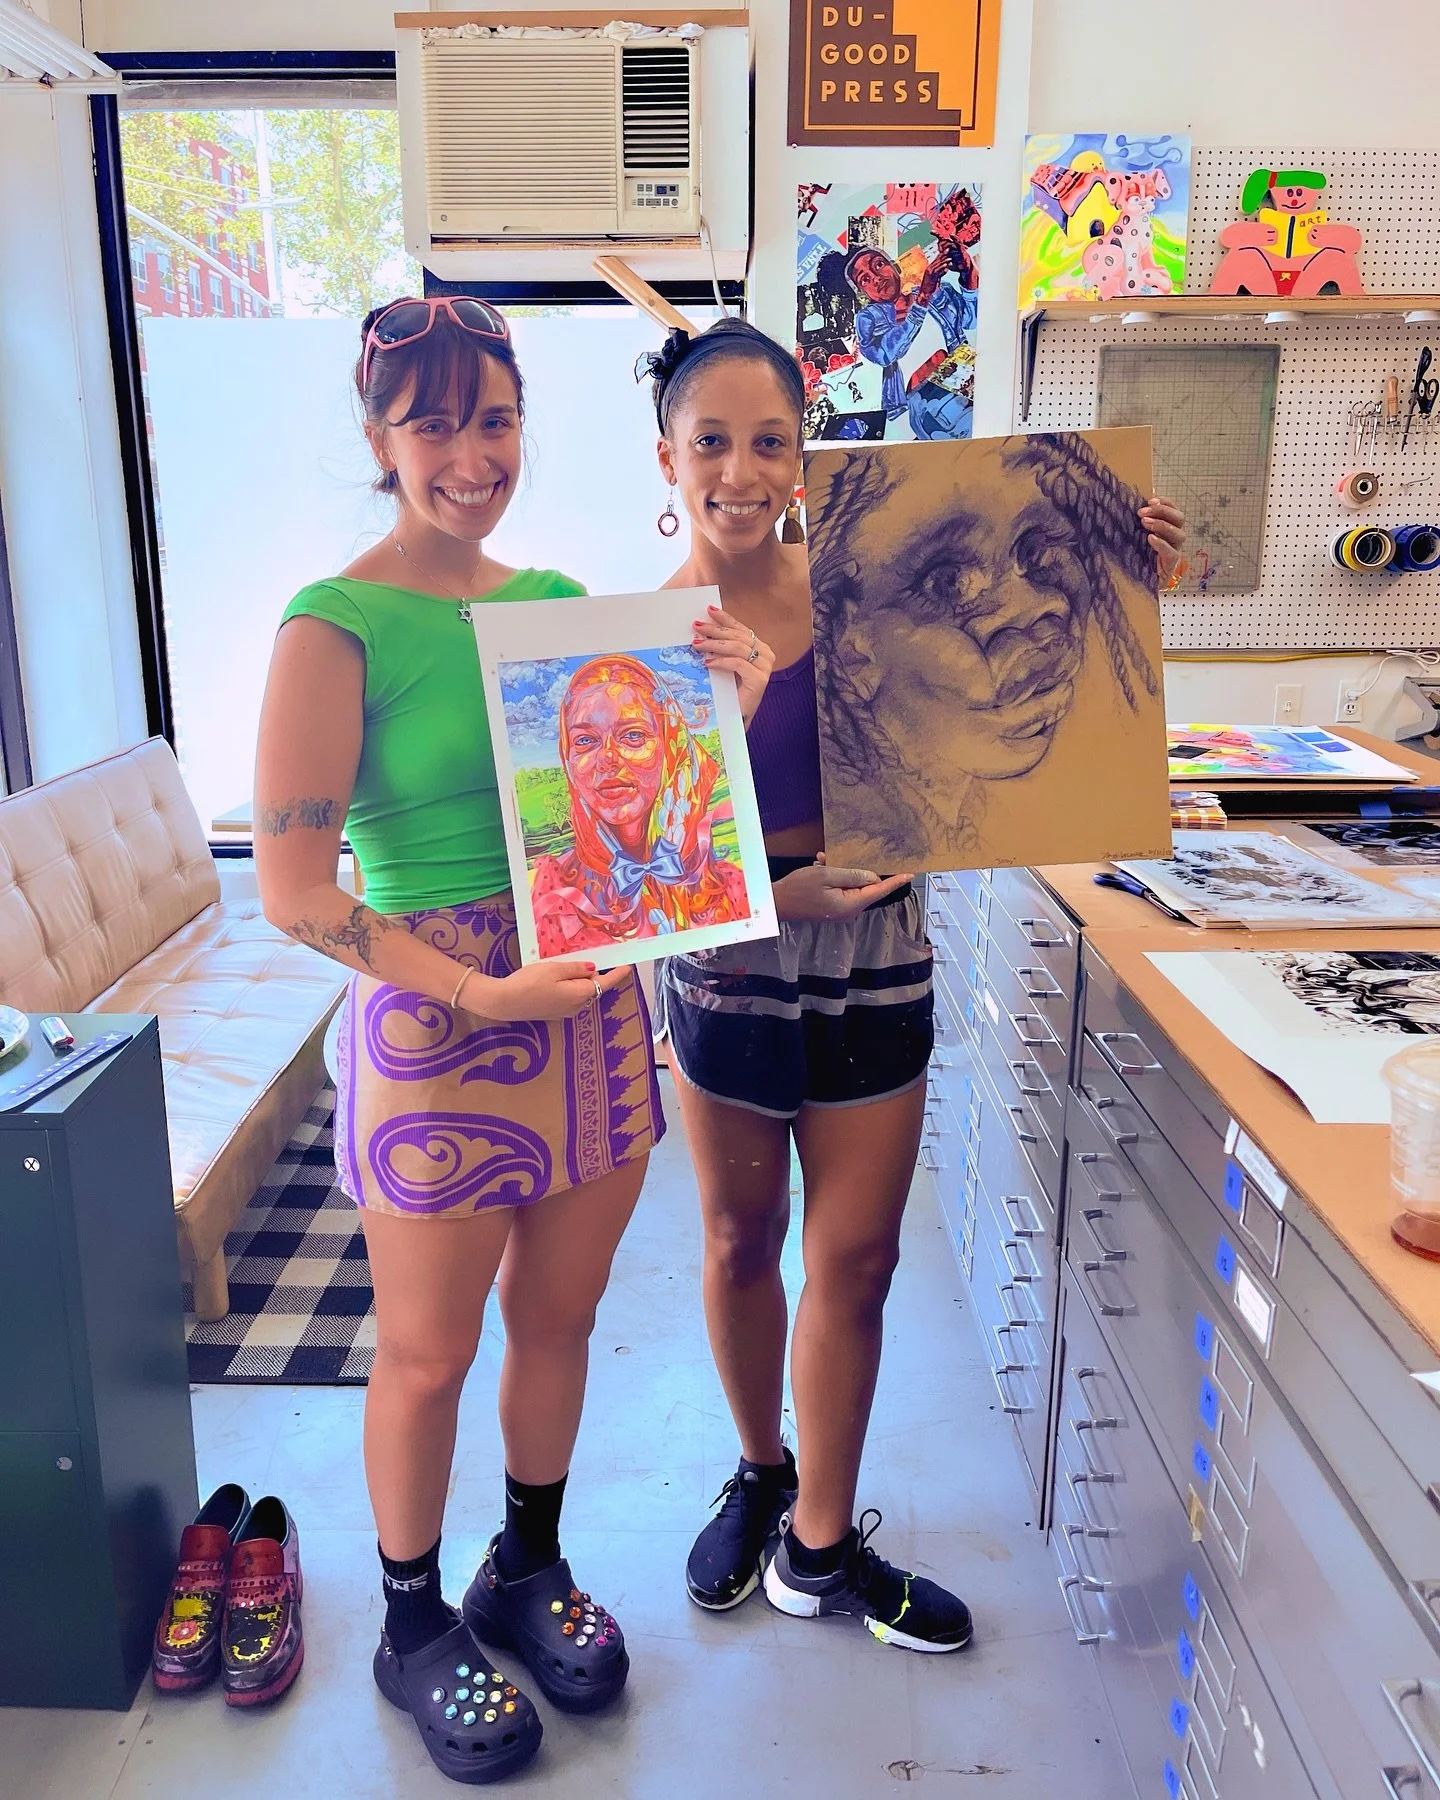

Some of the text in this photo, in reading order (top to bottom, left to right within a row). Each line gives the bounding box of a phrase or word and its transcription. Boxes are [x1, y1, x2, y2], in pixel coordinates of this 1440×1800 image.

[822, 6, 885, 27] DU-
[820, 43, 910, 65] GOOD
[820, 80, 932, 103] PRESS
